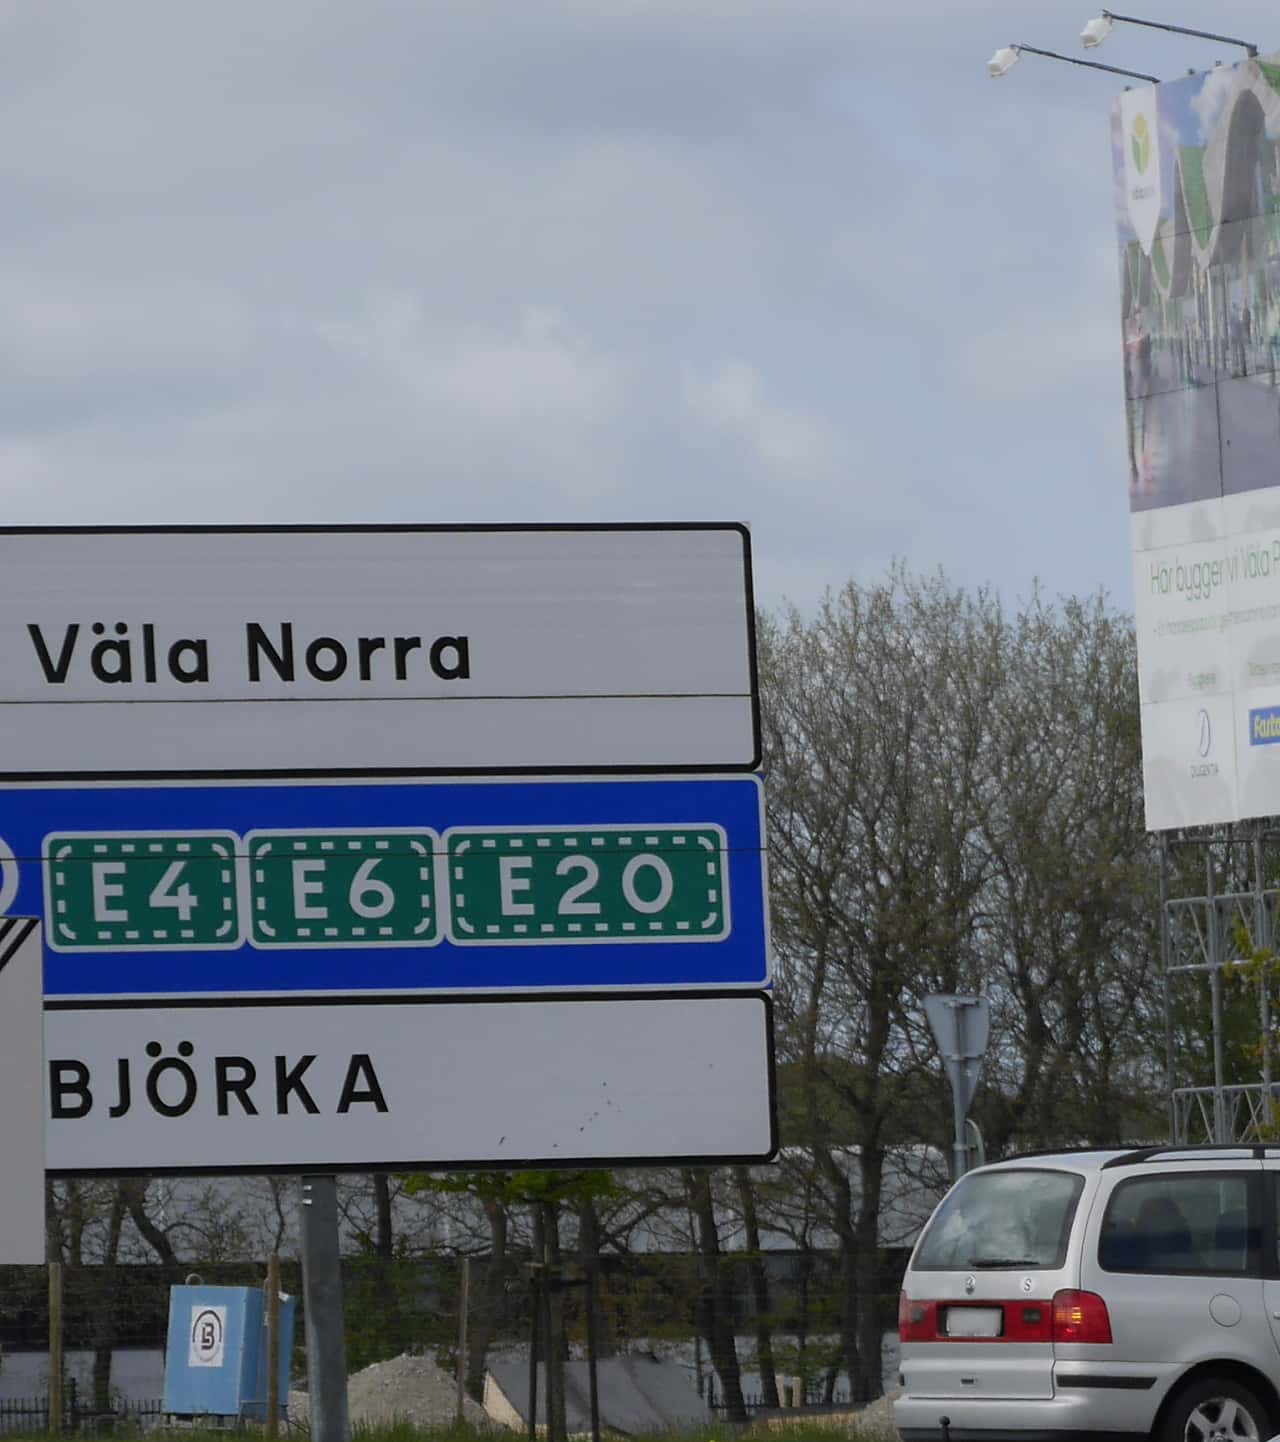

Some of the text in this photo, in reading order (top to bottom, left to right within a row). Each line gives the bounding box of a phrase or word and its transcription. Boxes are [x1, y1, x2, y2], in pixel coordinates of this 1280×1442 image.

[28, 622, 472, 684] Väla Norra
[49, 1040, 390, 1120] BJÖRKA
